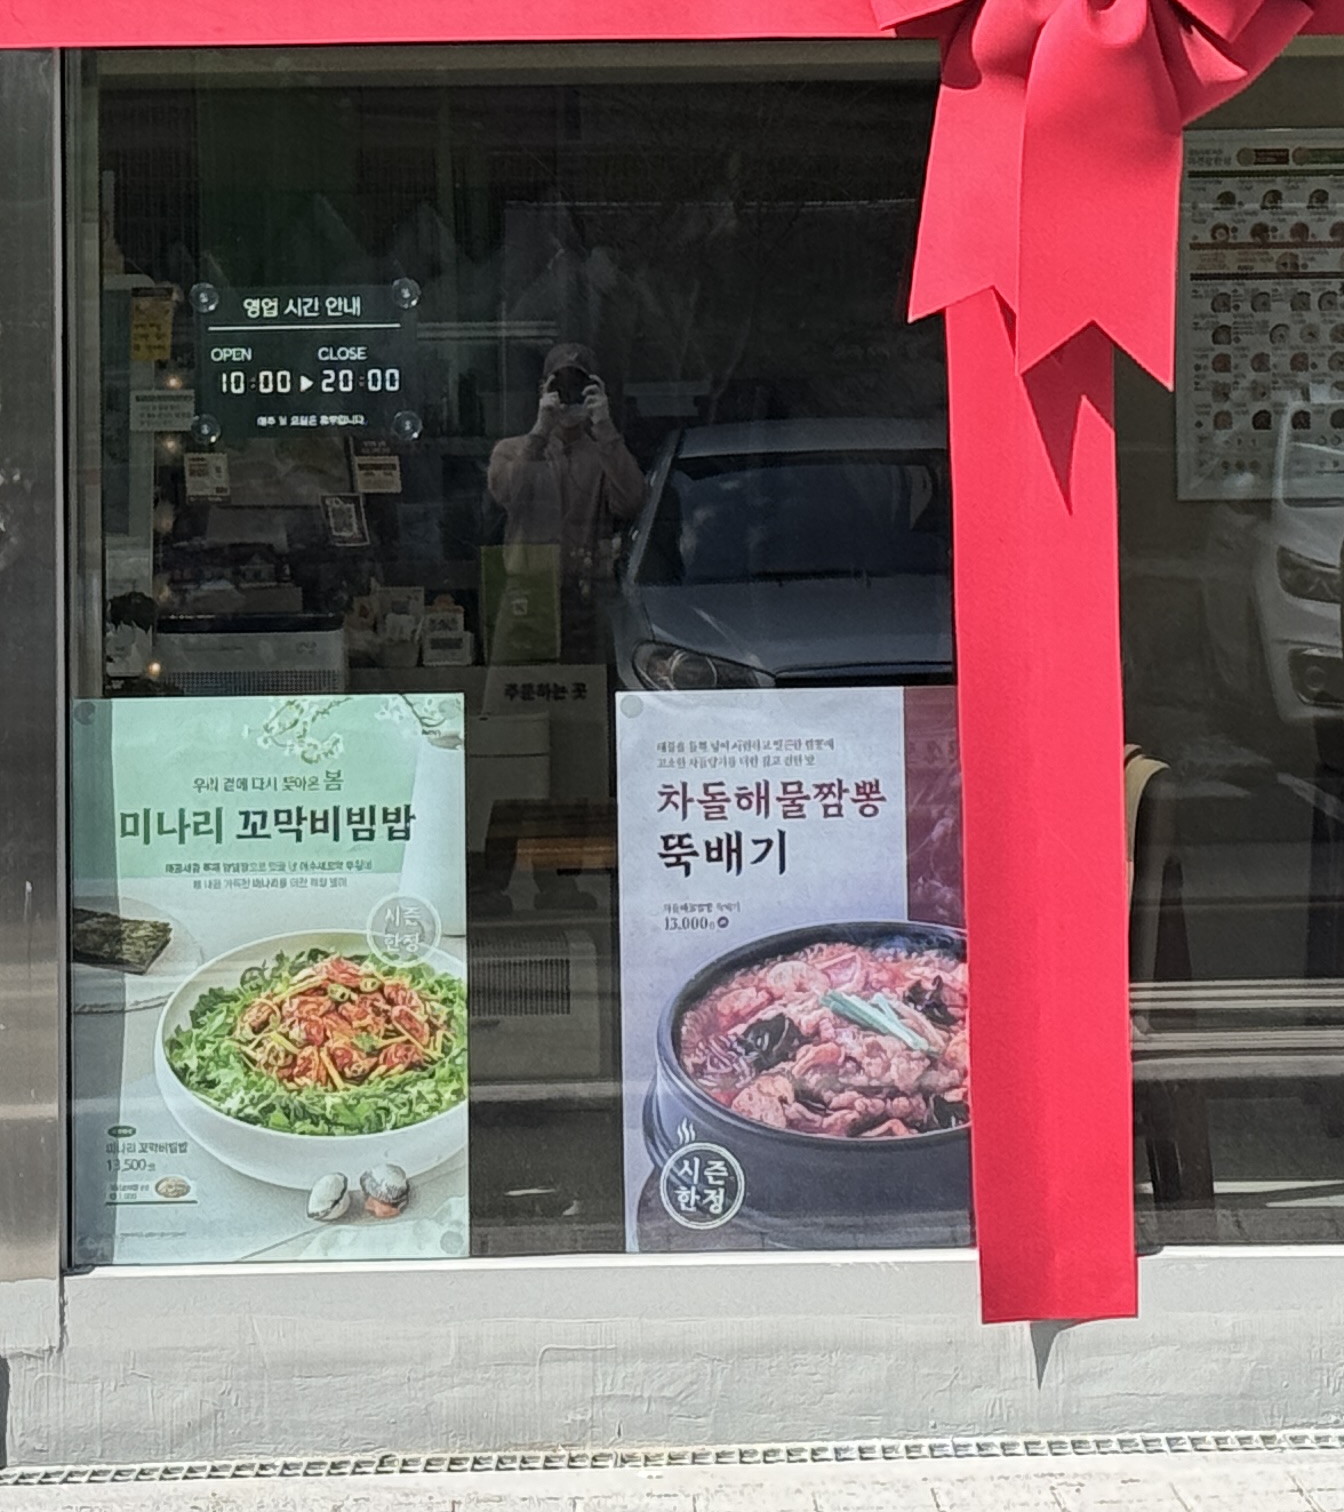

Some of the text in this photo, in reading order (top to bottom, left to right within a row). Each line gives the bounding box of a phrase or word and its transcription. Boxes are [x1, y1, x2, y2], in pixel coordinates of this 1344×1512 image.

[243, 295, 362, 319] 영업 시간 안내
[210, 346, 369, 363] OPEN CLOSE
[219, 368, 401, 395] 10:00 20:00
[323, 769, 345, 792] 봄
[657, 777, 888, 822] 차돌해물짬뽕
[119, 804, 416, 846] 미나리 꼬막비빔밥
[657, 828, 787, 879] 뚝배기
[676, 1157, 729, 1184] 시즌
[676, 1185, 729, 1214] 한정
